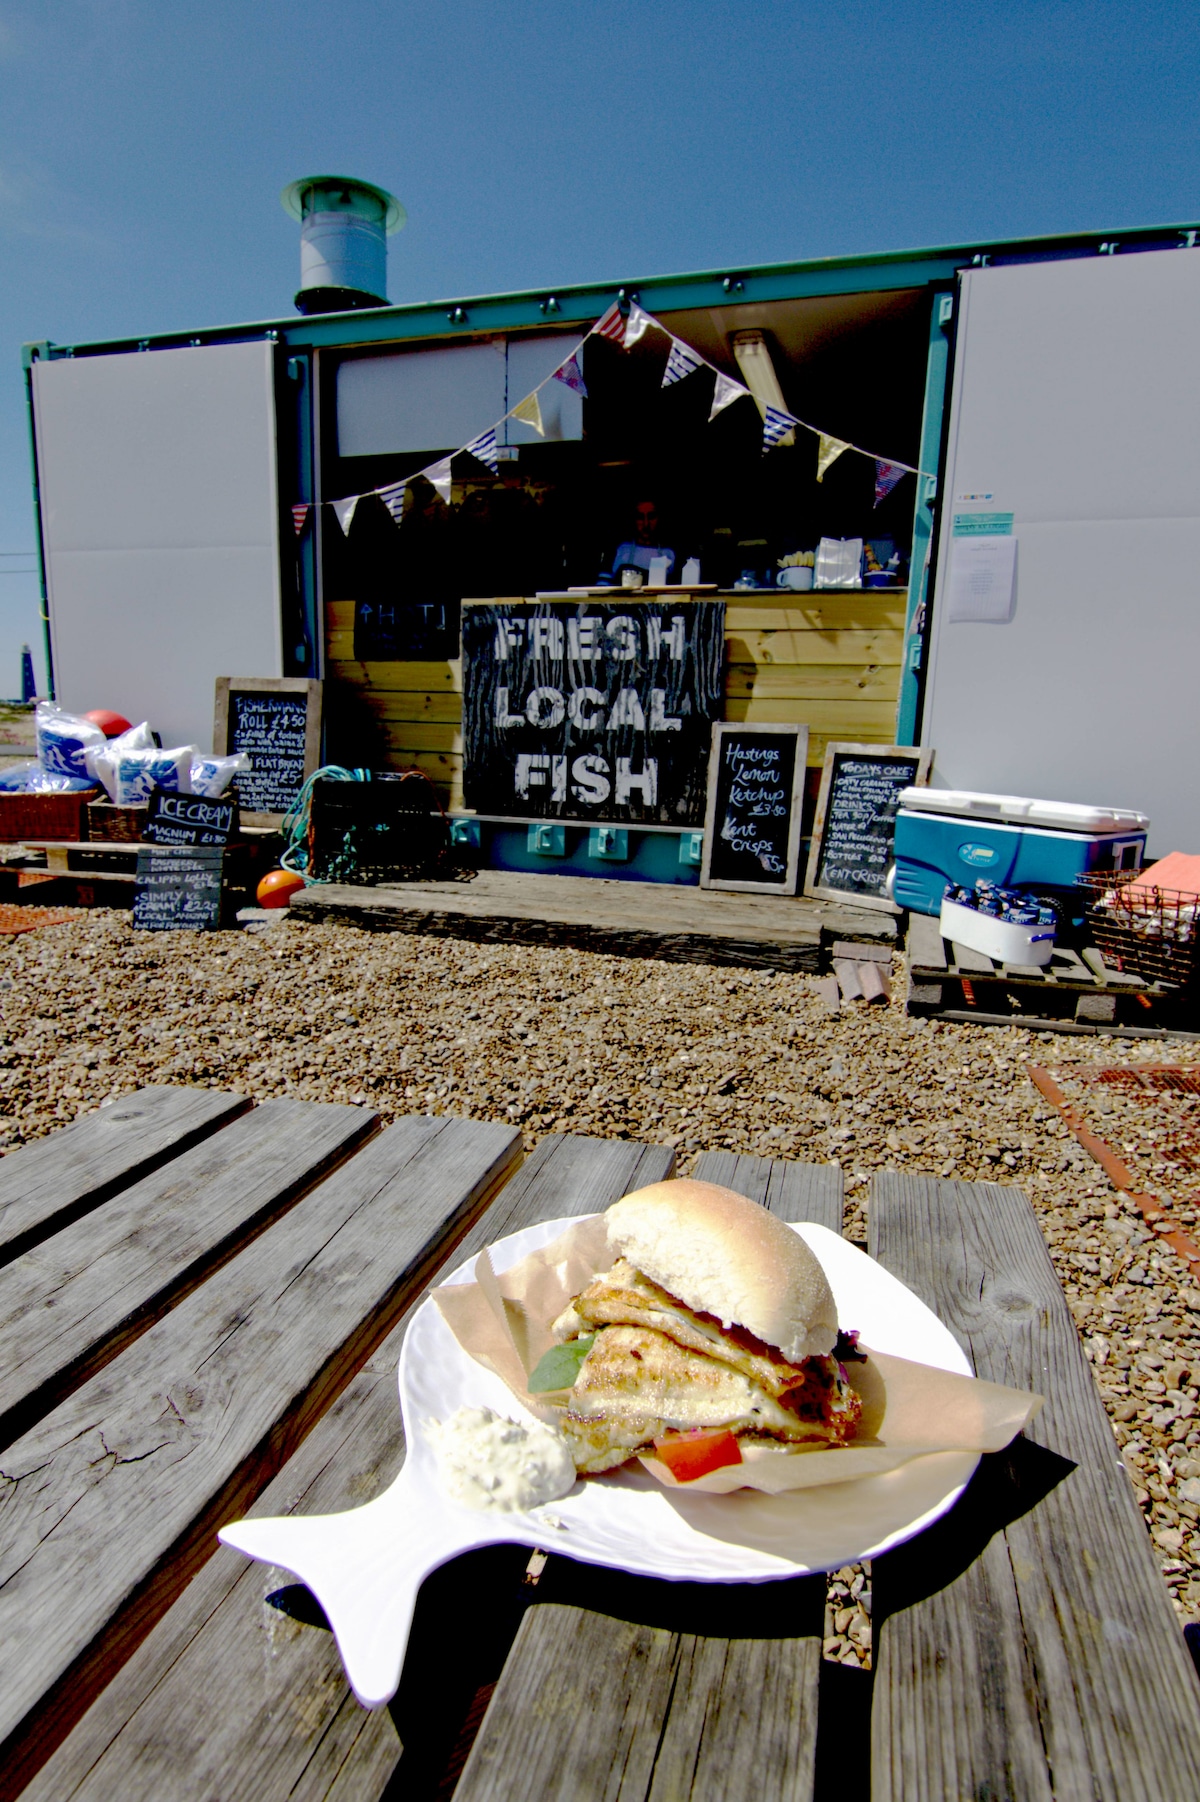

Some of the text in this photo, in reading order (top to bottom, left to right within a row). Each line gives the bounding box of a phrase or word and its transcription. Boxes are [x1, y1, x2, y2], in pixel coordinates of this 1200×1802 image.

[495, 616, 685, 660] FRESH
[495, 687, 682, 731] LOCAL
[239, 713, 268, 729] ROLL
[726, 743, 779, 771] Hastings
[514, 754, 658, 806] FISH
[733, 763, 780, 786] Lemon
[729, 785, 784, 807] Ketchup
[160, 796, 233, 832] ICE CREAM
[148, 824, 196, 842] MAGNUM
[721, 817, 756, 839] Kent
[731, 840, 773, 856] Crisps
[137, 873, 213, 884] CALIPPO LOLLY
[821, 863, 886, 883] KENT CRISP
[140, 891, 183, 904] SIMPLY
